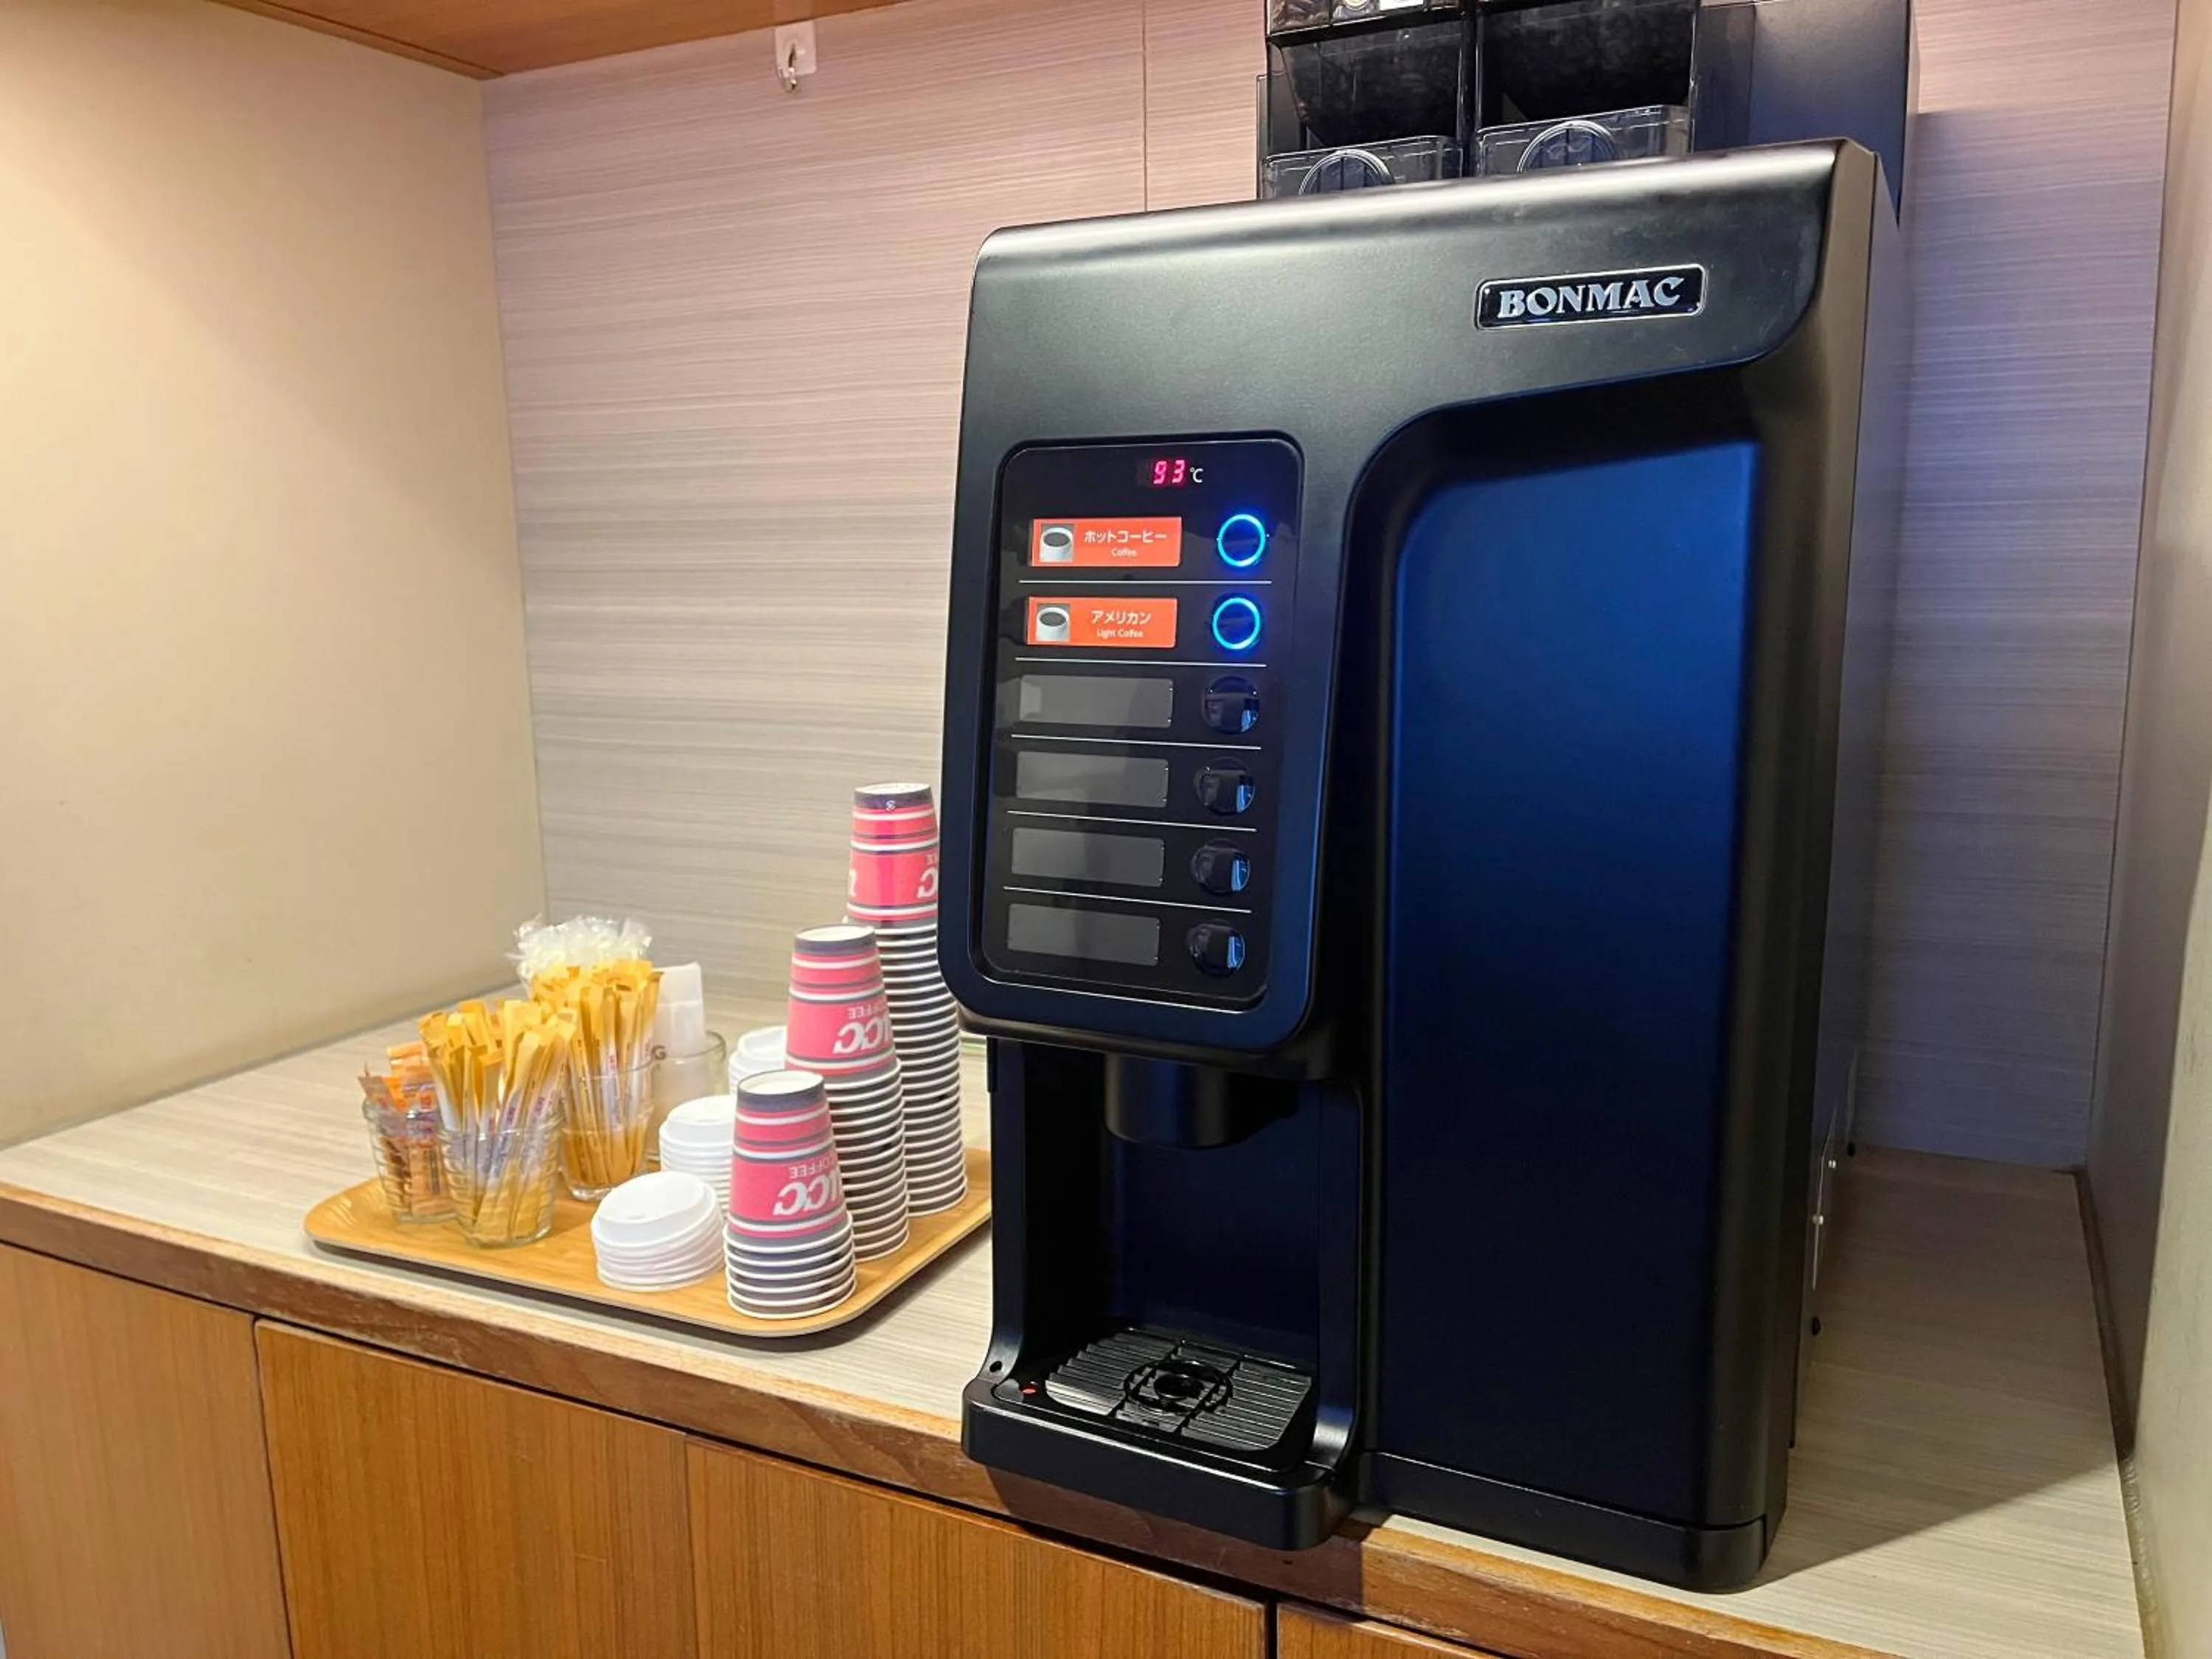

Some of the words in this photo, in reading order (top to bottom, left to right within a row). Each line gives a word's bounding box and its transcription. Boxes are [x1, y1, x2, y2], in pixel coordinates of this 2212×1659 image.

[1498, 276, 1685, 319] BONMAC
[1153, 459, 1186, 484] 93
[1085, 529, 1168, 544] ホットコーヒー
[1111, 548, 1138, 557] Coffee
[1091, 609, 1152, 625] アメリカン
[1096, 627, 1116, 639] Light
[1117, 629, 1144, 639] Coffee
